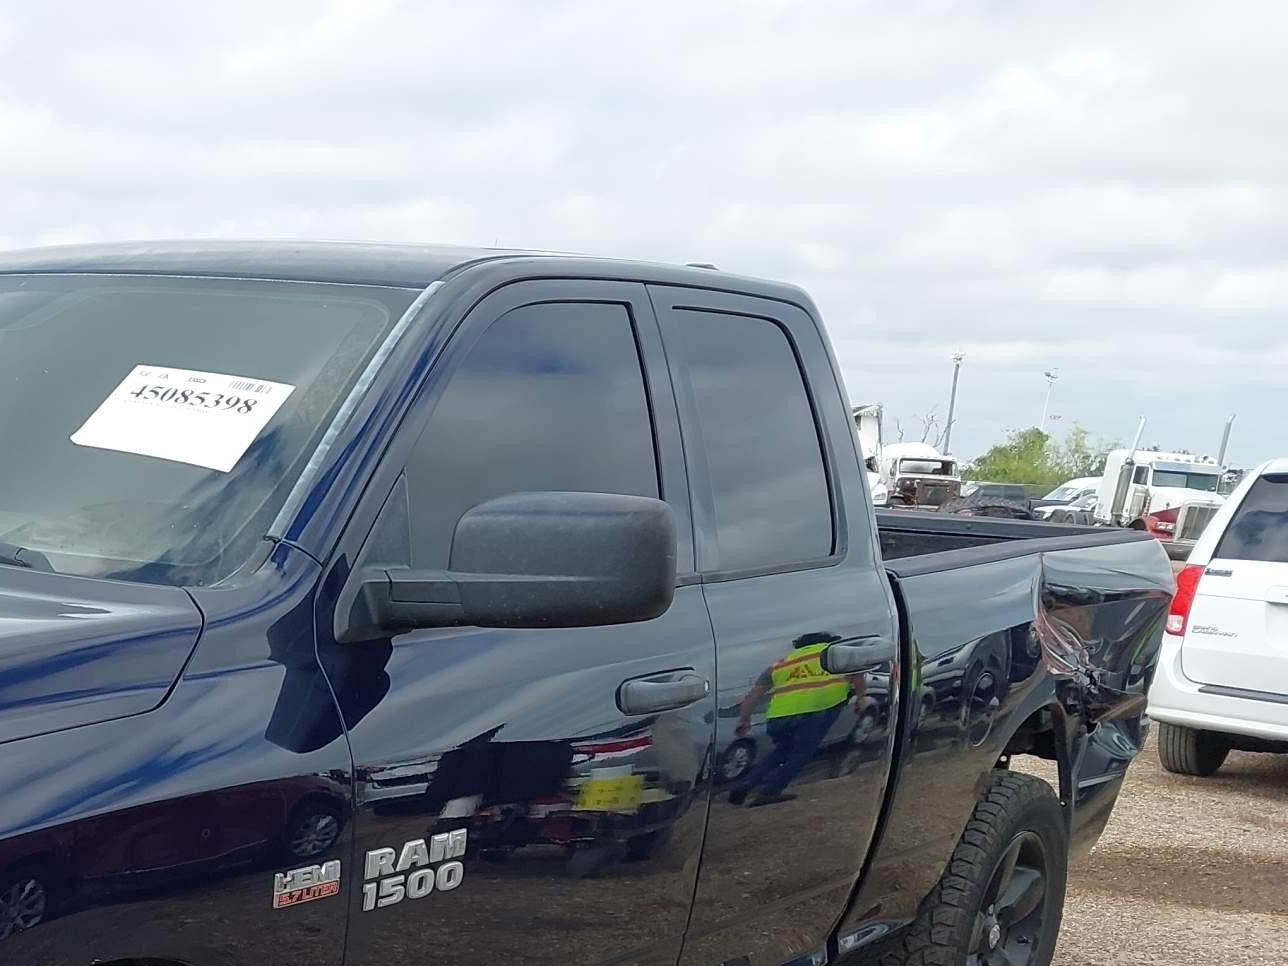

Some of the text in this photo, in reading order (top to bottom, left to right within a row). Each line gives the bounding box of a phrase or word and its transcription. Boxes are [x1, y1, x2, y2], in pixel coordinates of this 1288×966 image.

[129, 384, 258, 415] 45085398
[364, 828, 468, 880] RAM
[275, 860, 341, 893] HEMI
[362, 860, 464, 912] 1500
[279, 881, 338, 906] 5.7 LITER
